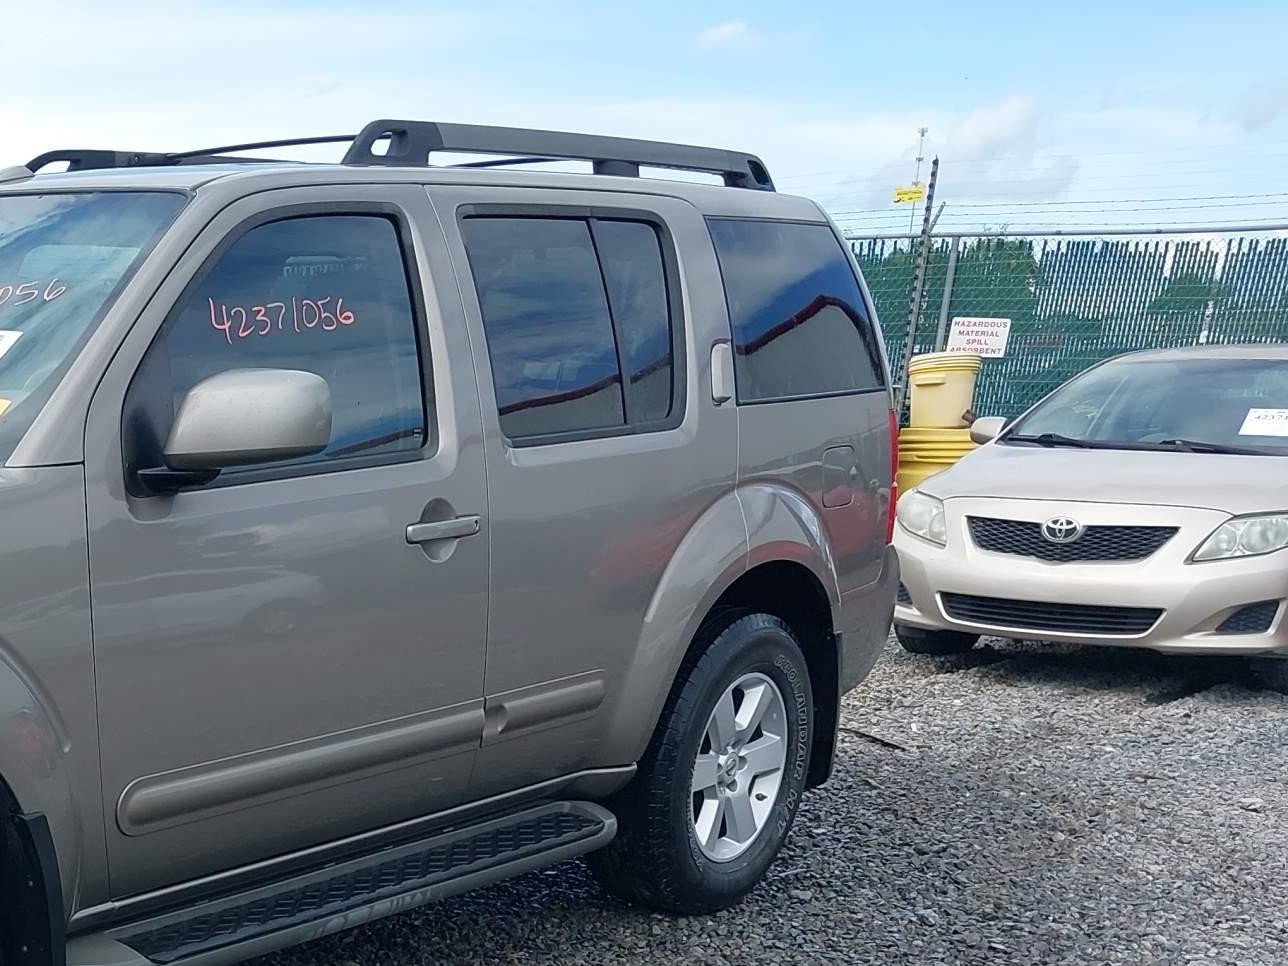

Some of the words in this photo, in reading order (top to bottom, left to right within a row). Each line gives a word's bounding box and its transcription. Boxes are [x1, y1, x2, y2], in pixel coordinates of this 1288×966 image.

[208, 296, 355, 345] 42371056
[954, 320, 1008, 329] HAZARDOUS
[966, 338, 989, 346] SPILL
